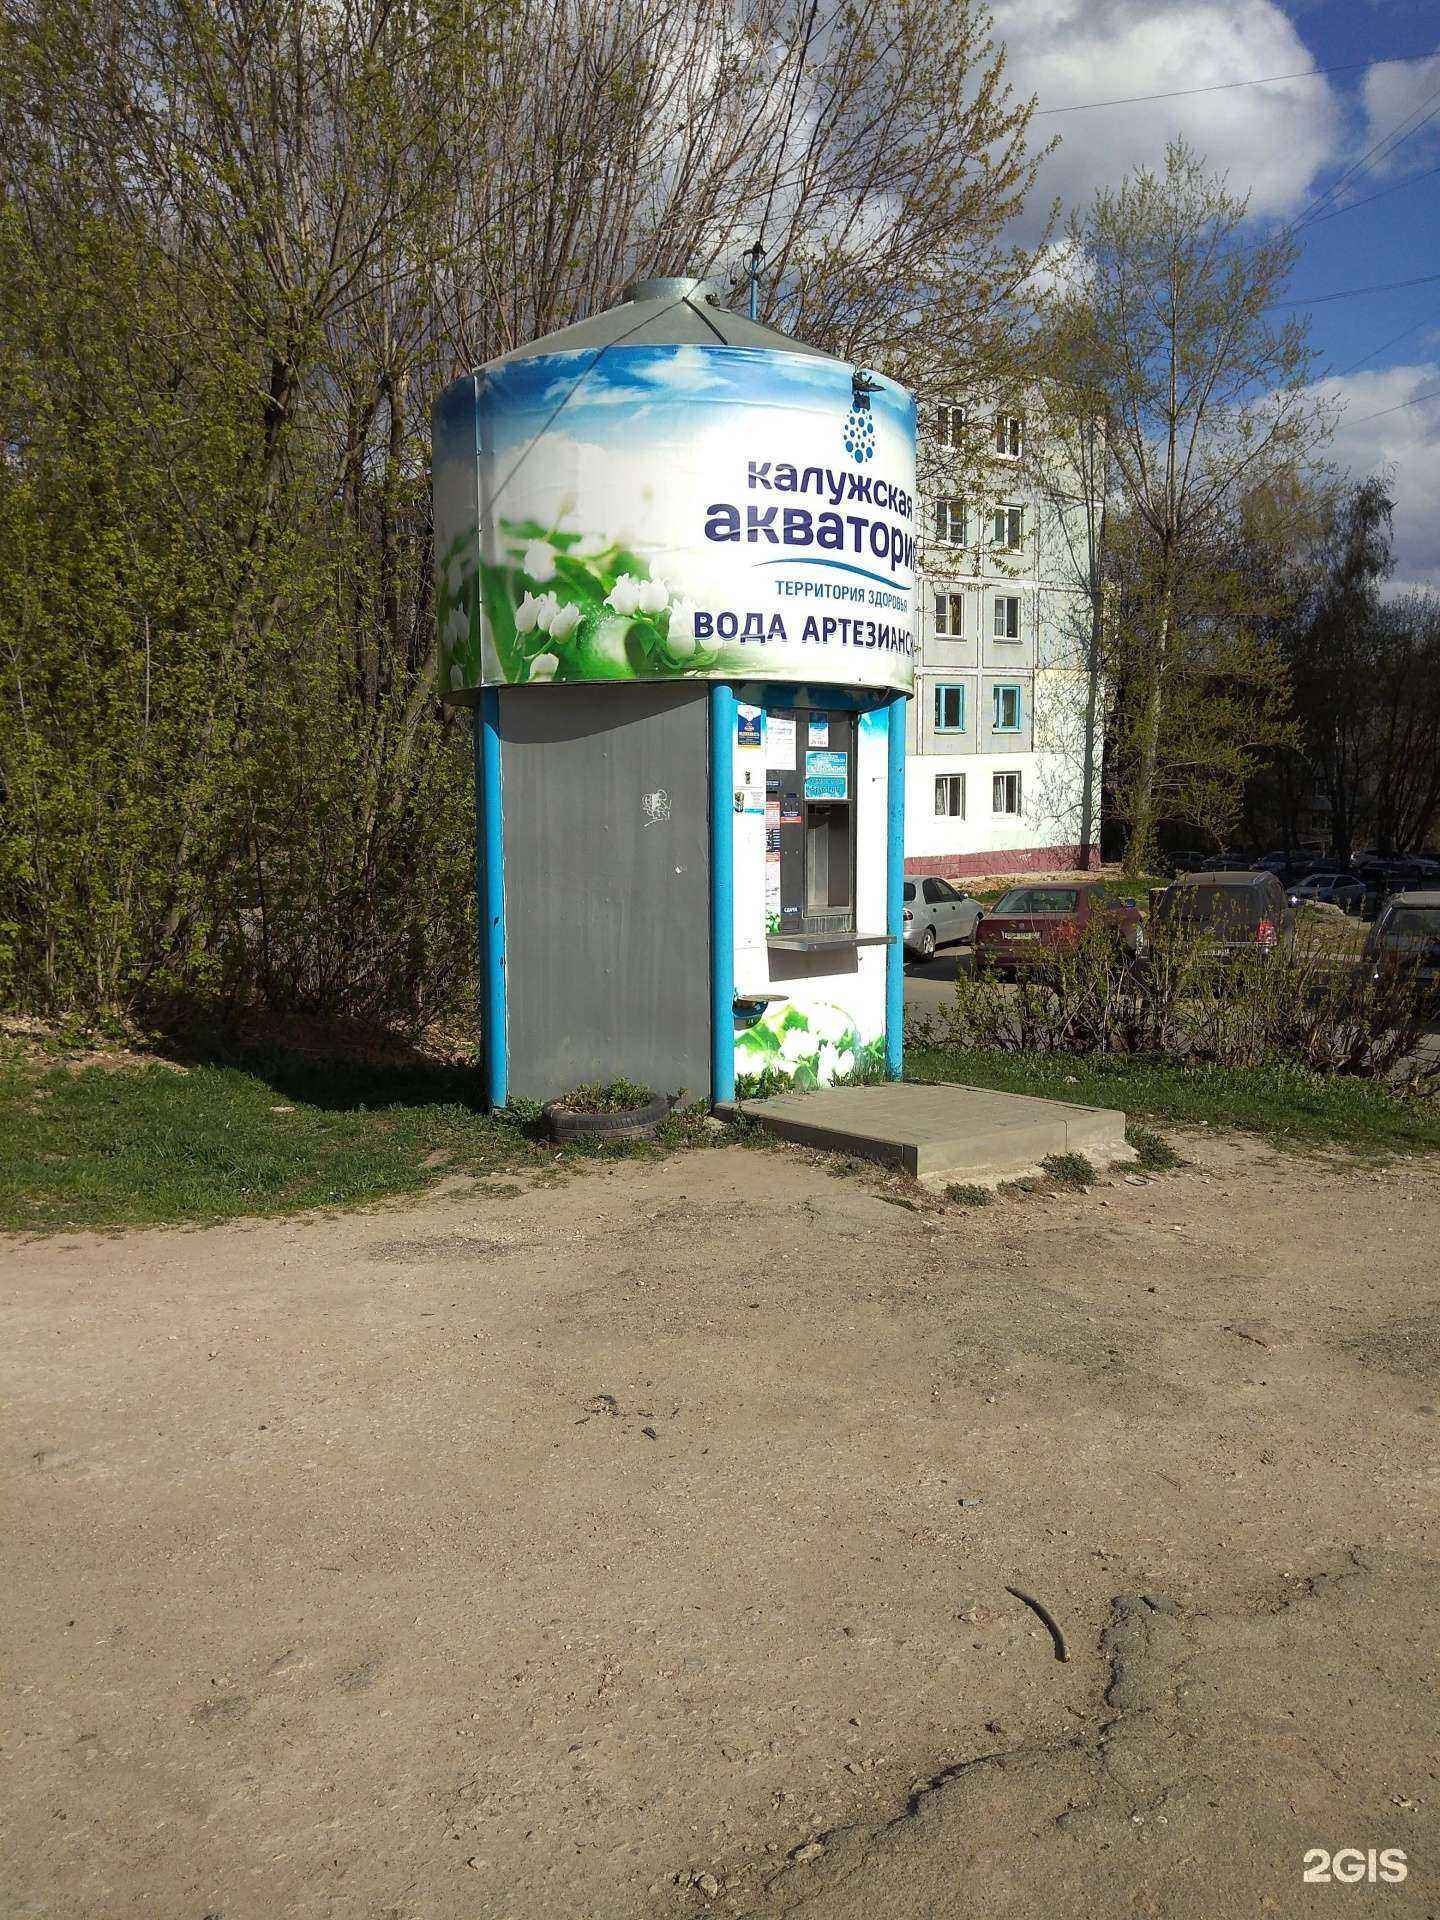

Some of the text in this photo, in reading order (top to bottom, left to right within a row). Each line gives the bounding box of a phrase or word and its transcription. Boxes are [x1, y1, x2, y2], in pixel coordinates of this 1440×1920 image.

[748, 461, 913, 521] калужская
[775, 580, 908, 614] ТЕРРИТОРИЯ ЗДОРОВЬЯ
[694, 611, 788, 644] ВОДА
